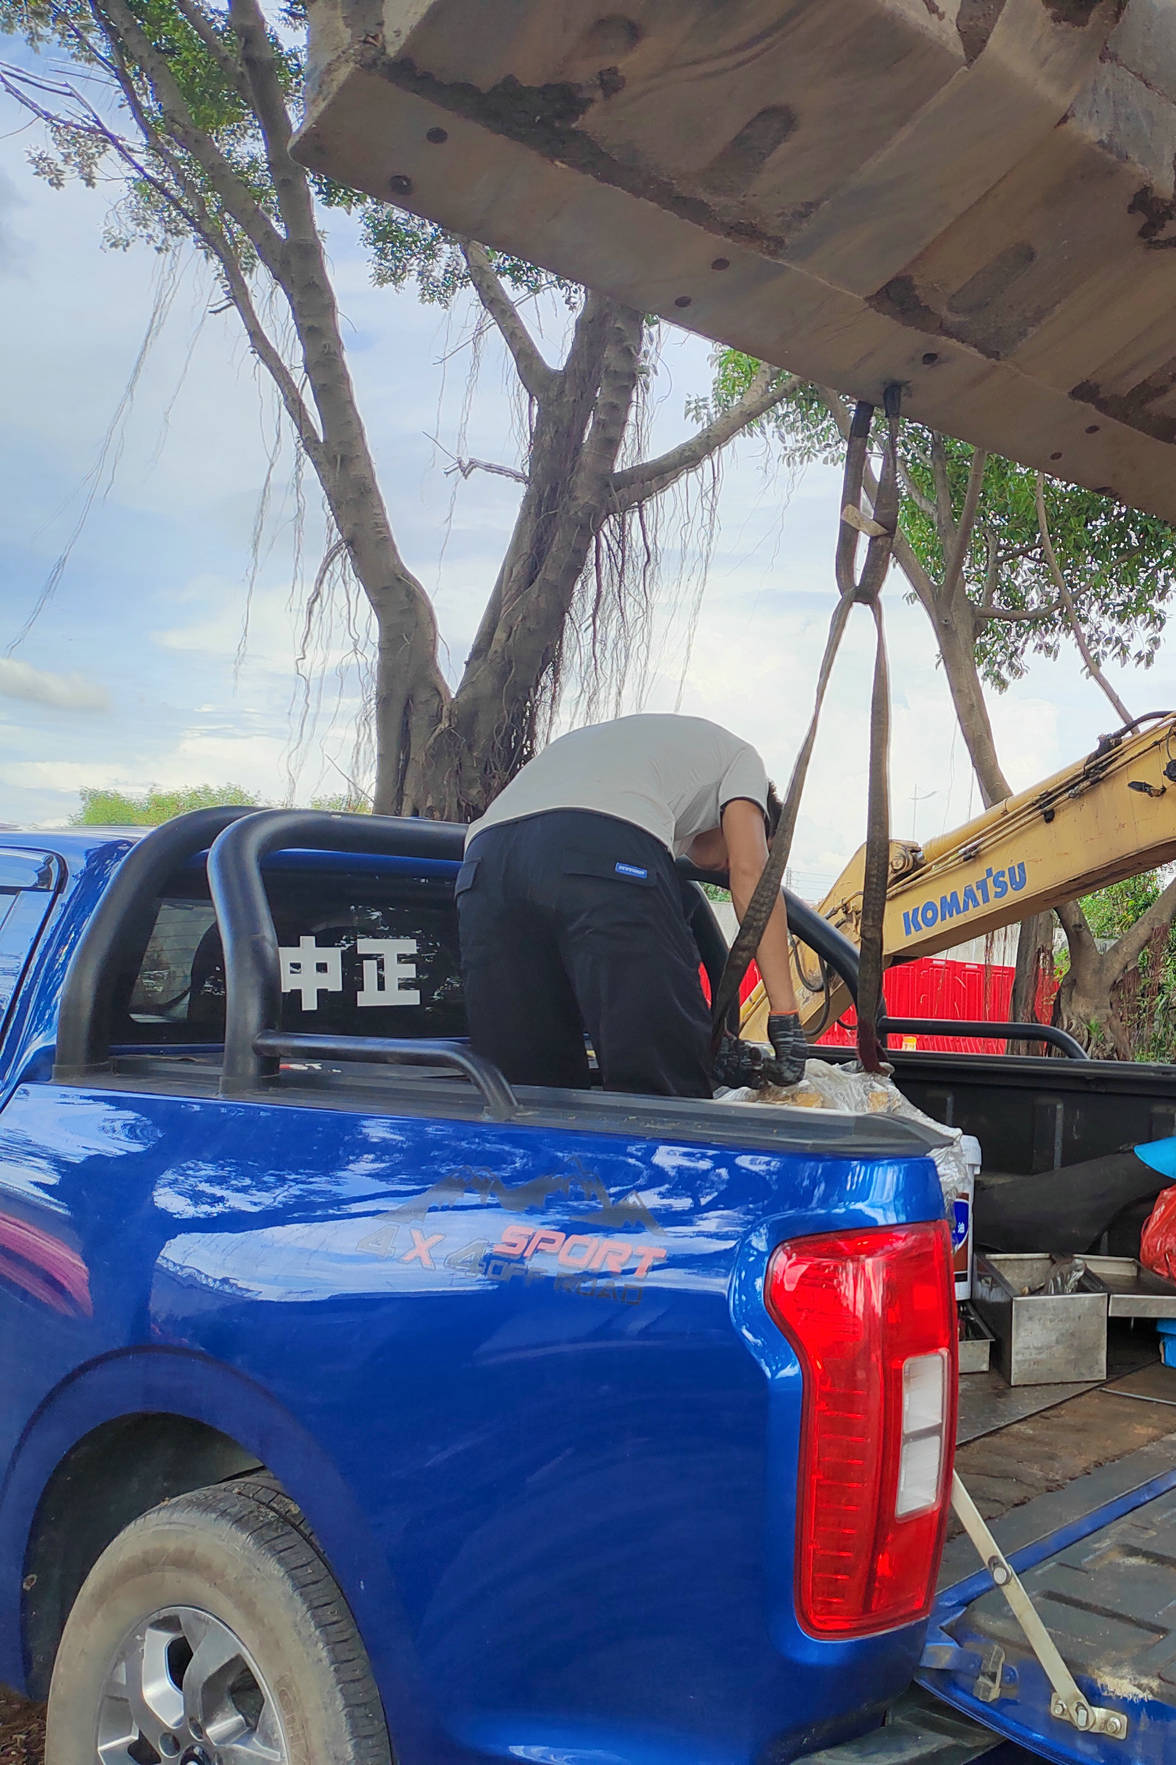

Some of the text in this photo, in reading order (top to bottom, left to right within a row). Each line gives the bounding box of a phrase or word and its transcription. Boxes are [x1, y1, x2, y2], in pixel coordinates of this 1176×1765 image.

[902, 861, 1027, 936] KOMATSU
[279, 936, 421, 1011] 中正
[494, 1224, 667, 1280] SPORT
